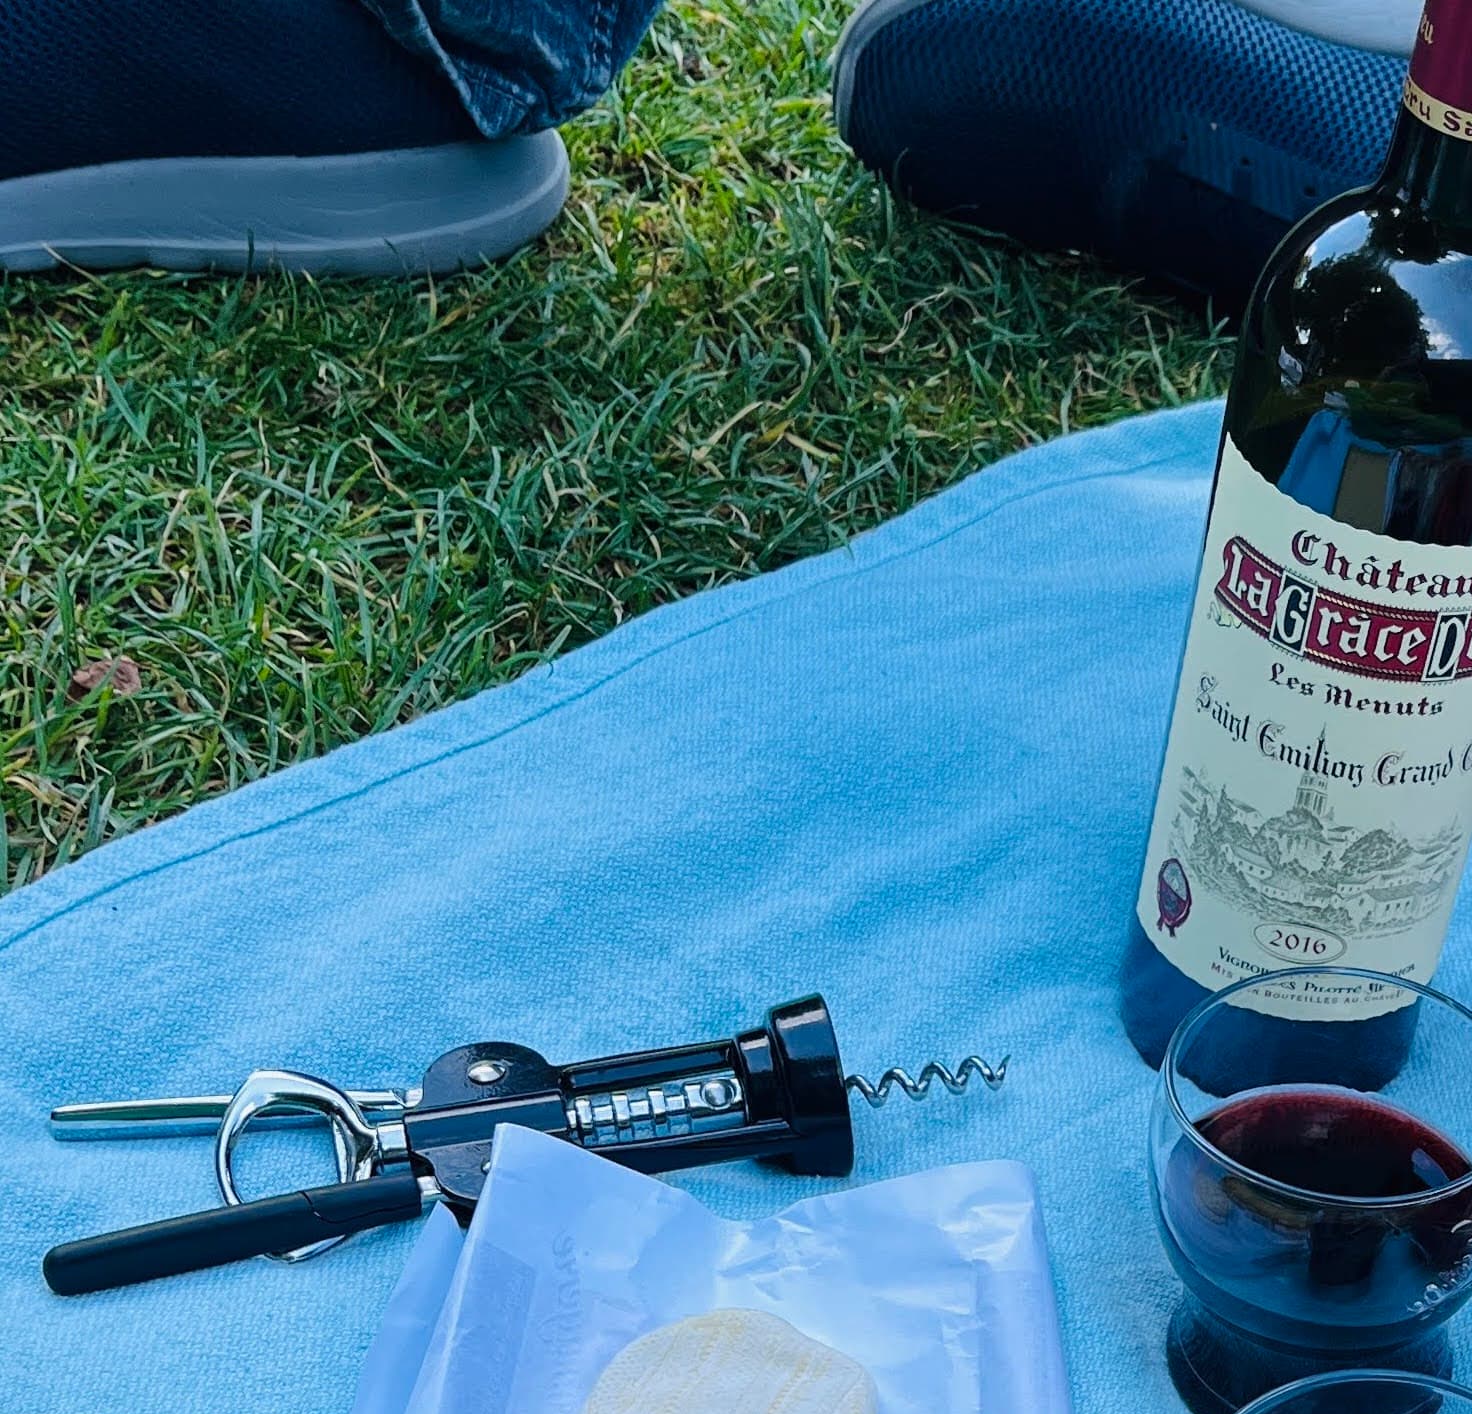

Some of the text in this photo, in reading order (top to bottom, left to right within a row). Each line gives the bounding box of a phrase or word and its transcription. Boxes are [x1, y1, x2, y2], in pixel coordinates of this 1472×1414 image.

[1226, 544, 1272, 617] La
[1268, 662, 1444, 716] Les Menuts
[1195, 672, 1250, 743] Saint
[1256, 720, 1365, 788] Emilion
[1373, 748, 1453, 787] Grand
[1269, 930, 1327, 955] 2016
